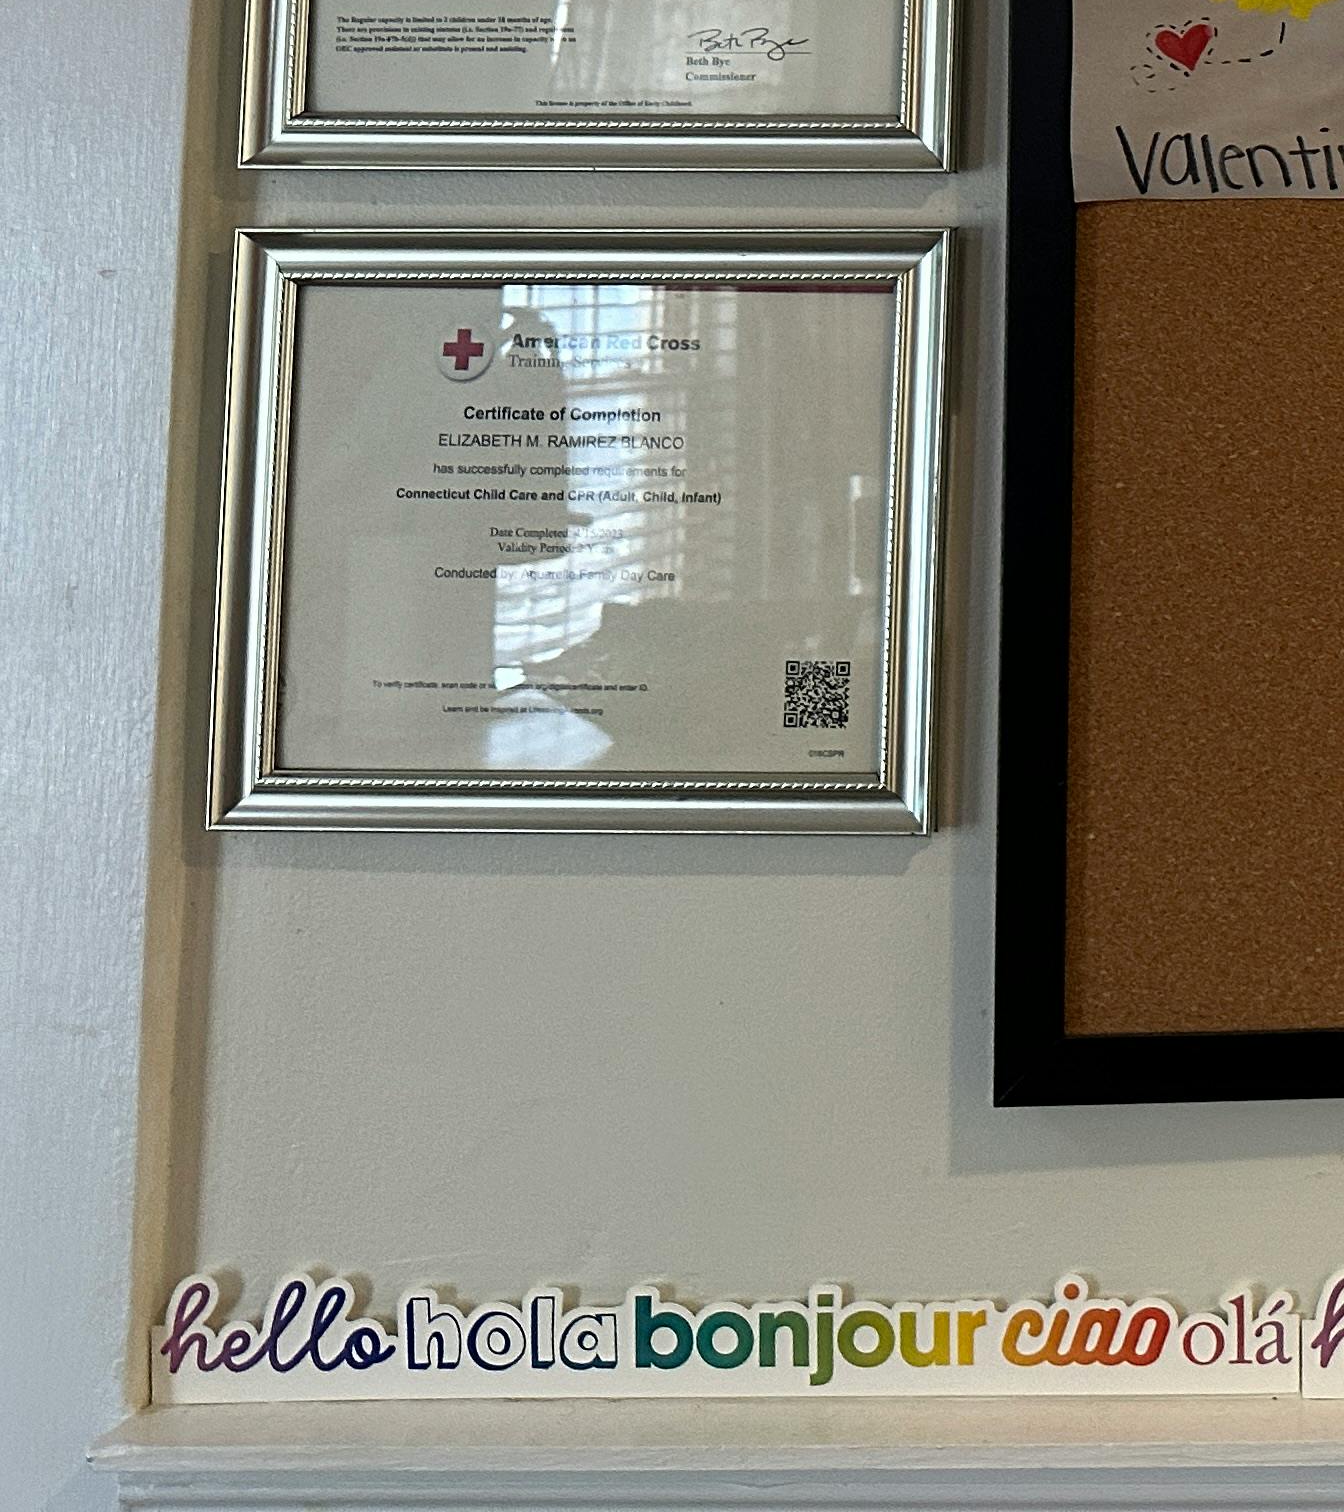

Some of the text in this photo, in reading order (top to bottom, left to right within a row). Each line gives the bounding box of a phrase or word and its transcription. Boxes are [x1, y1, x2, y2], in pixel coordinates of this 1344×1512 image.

[647, 336, 701, 351] Cross
[463, 405, 662, 424] Certificate of Completion
[438, 433, 523, 448] ELIZABETH
[547, 434, 617, 450] RAMIREZ
[620, 435, 685, 451] BLANCO
[395, 487, 471, 500] Connecticut
[473, 488, 506, 501] Child
[508, 488, 539, 502] Care
[540, 489, 565, 502] and
[568, 490, 594, 501] CPR
[642, 491, 678, 504] Child,
[681, 492, 722, 505] Infant)
[161, 1281, 1293, 1386] hello hola bonjour ciao olá
